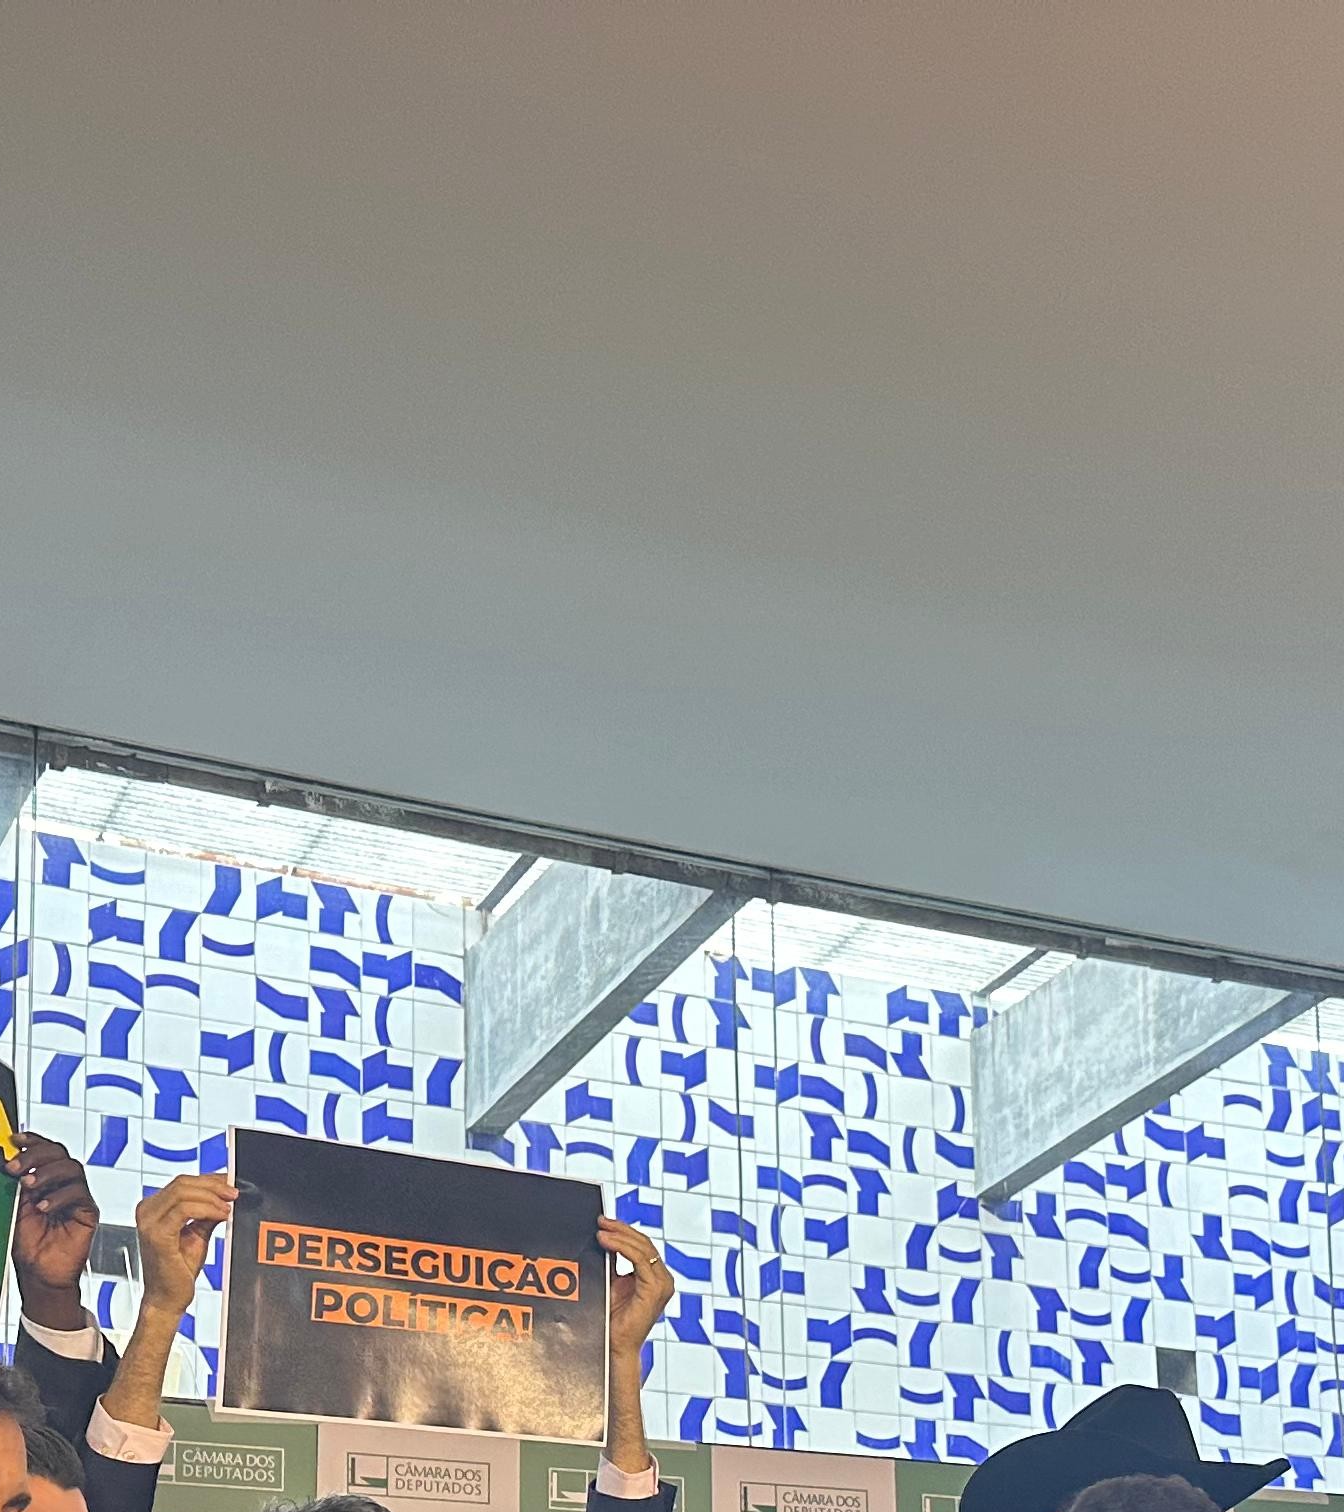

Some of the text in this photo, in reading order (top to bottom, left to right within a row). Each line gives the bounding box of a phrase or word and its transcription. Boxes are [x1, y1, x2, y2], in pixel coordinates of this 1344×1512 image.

[265, 1229, 578, 1298] PERSEGUIÇÃO
[182, 1447, 276, 1469] CÂMARA DOS
[182, 1463, 276, 1483] DEPUTADOS
[395, 1462, 482, 1483] CÂMARA DOS
[395, 1478, 482, 1496] DEPUTADOS
[782, 1490, 861, 1509] CÂMARA DOS
